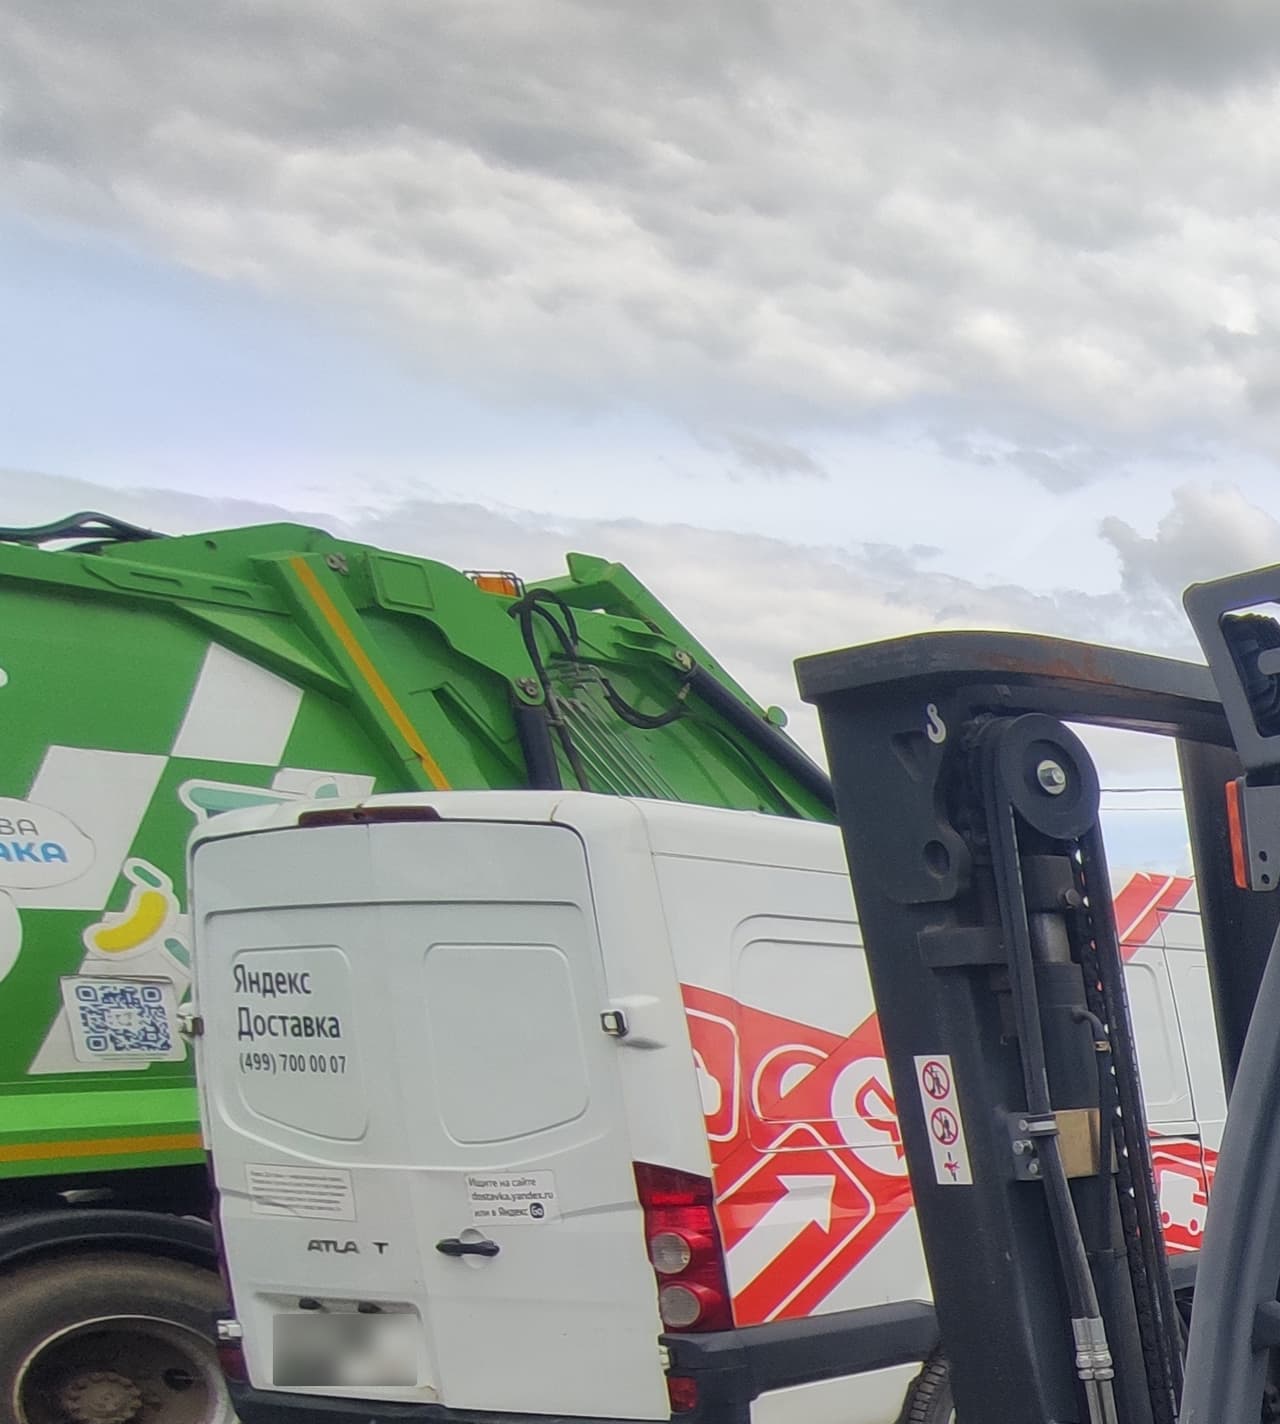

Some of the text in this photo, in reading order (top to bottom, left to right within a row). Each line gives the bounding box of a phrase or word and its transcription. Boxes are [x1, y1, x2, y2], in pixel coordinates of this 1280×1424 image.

[233, 963, 312, 999] Яндекс
[238, 1006, 341, 1041] Доставка
[240, 1052, 346, 1075] (499) 700 00 07
